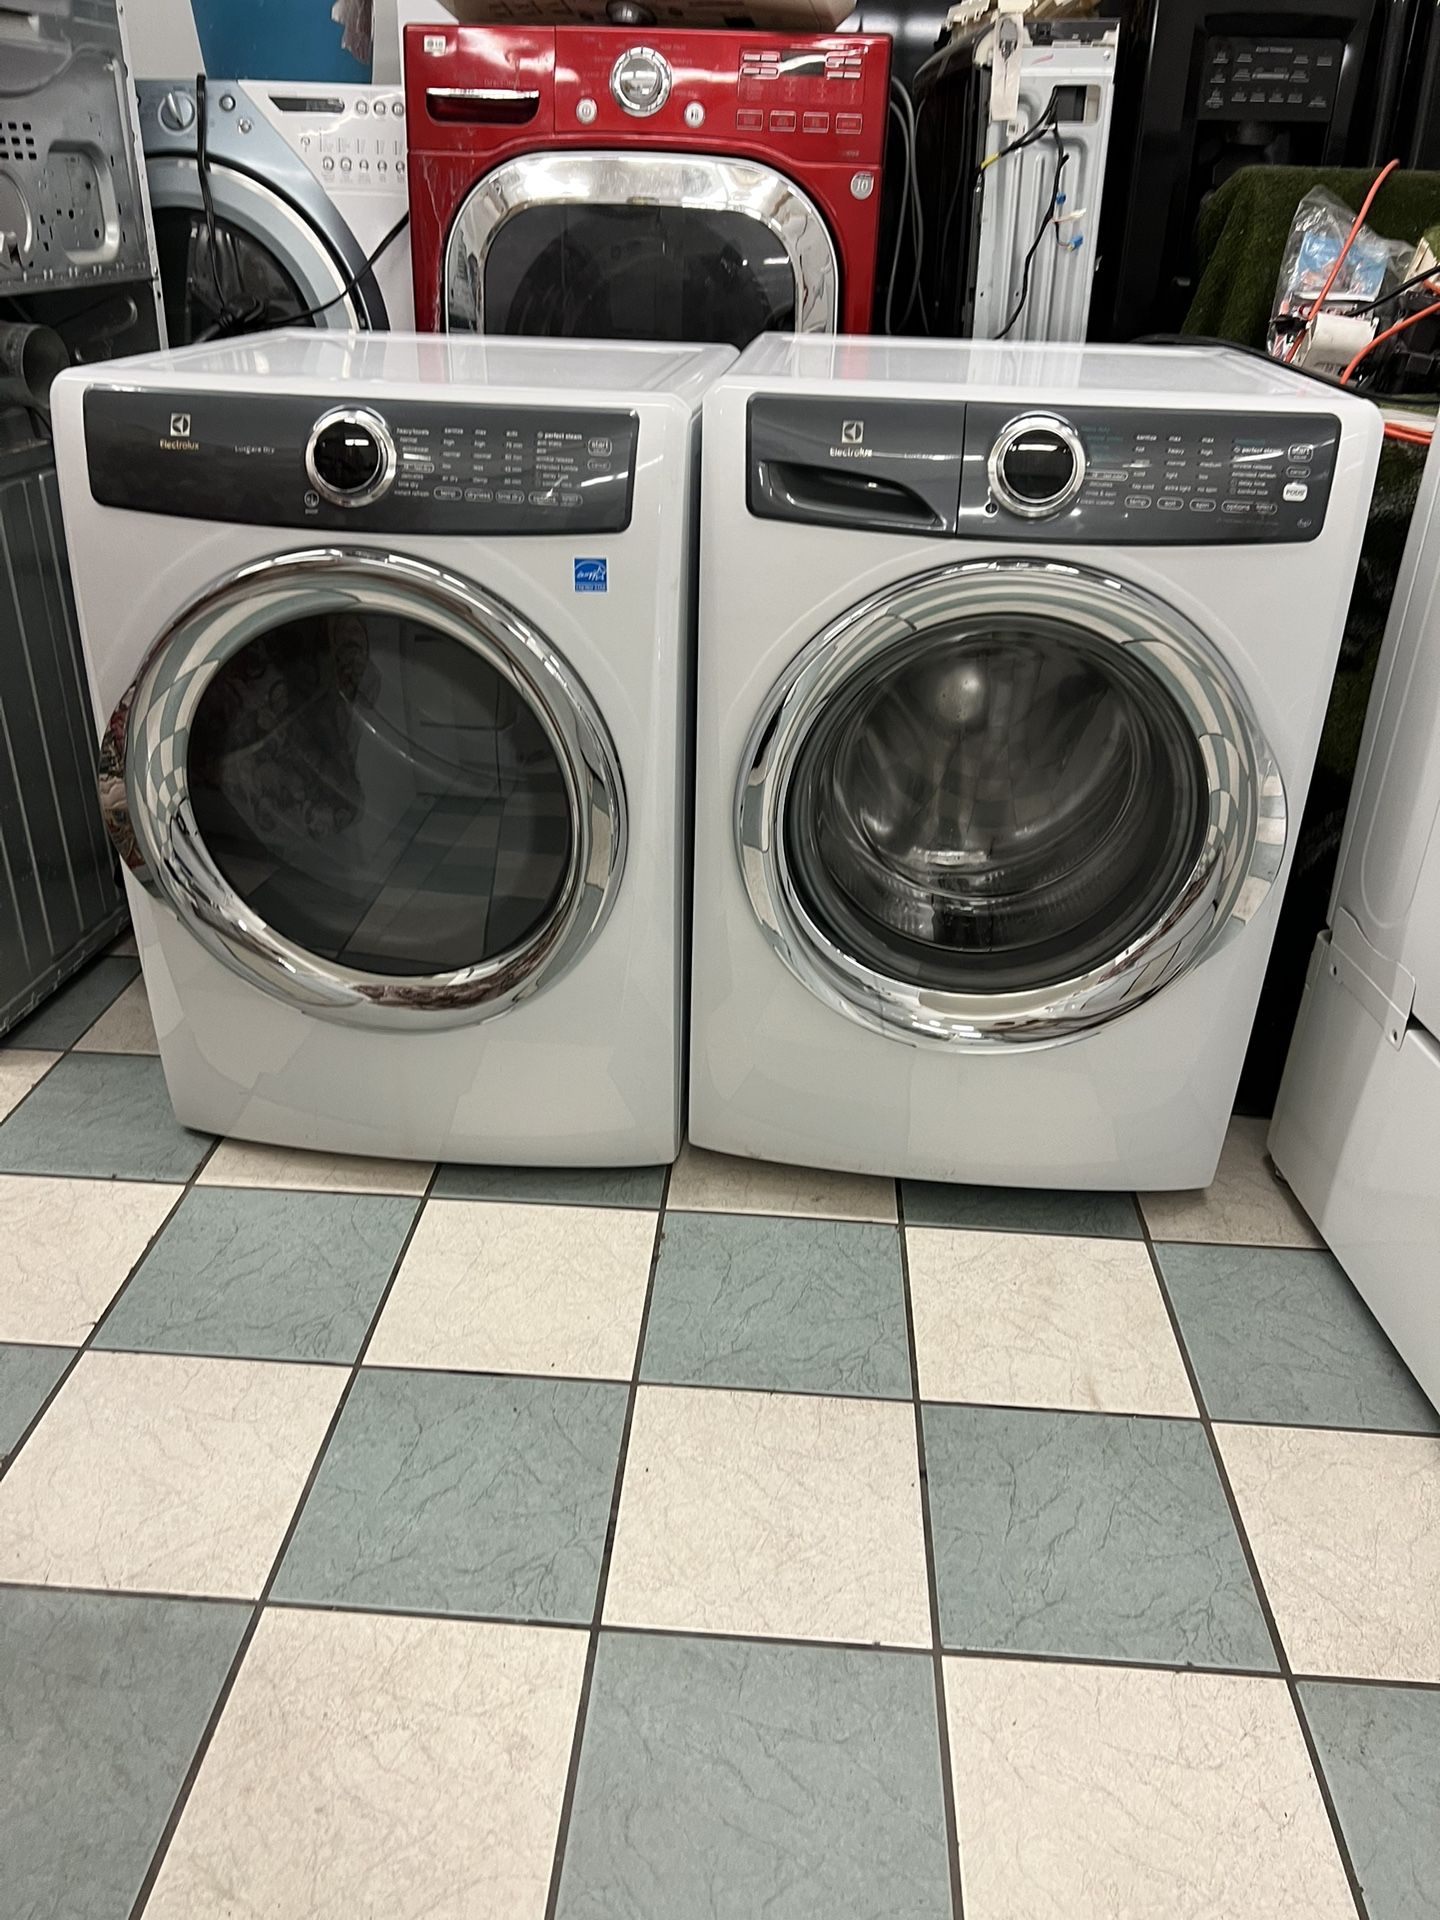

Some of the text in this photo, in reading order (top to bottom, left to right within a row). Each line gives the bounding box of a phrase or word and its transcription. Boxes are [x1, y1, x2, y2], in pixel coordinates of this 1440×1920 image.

[856, 179, 868, 192] 10
[160, 439, 200, 450] Electrolux
[830, 447, 873, 457] Electrolux
